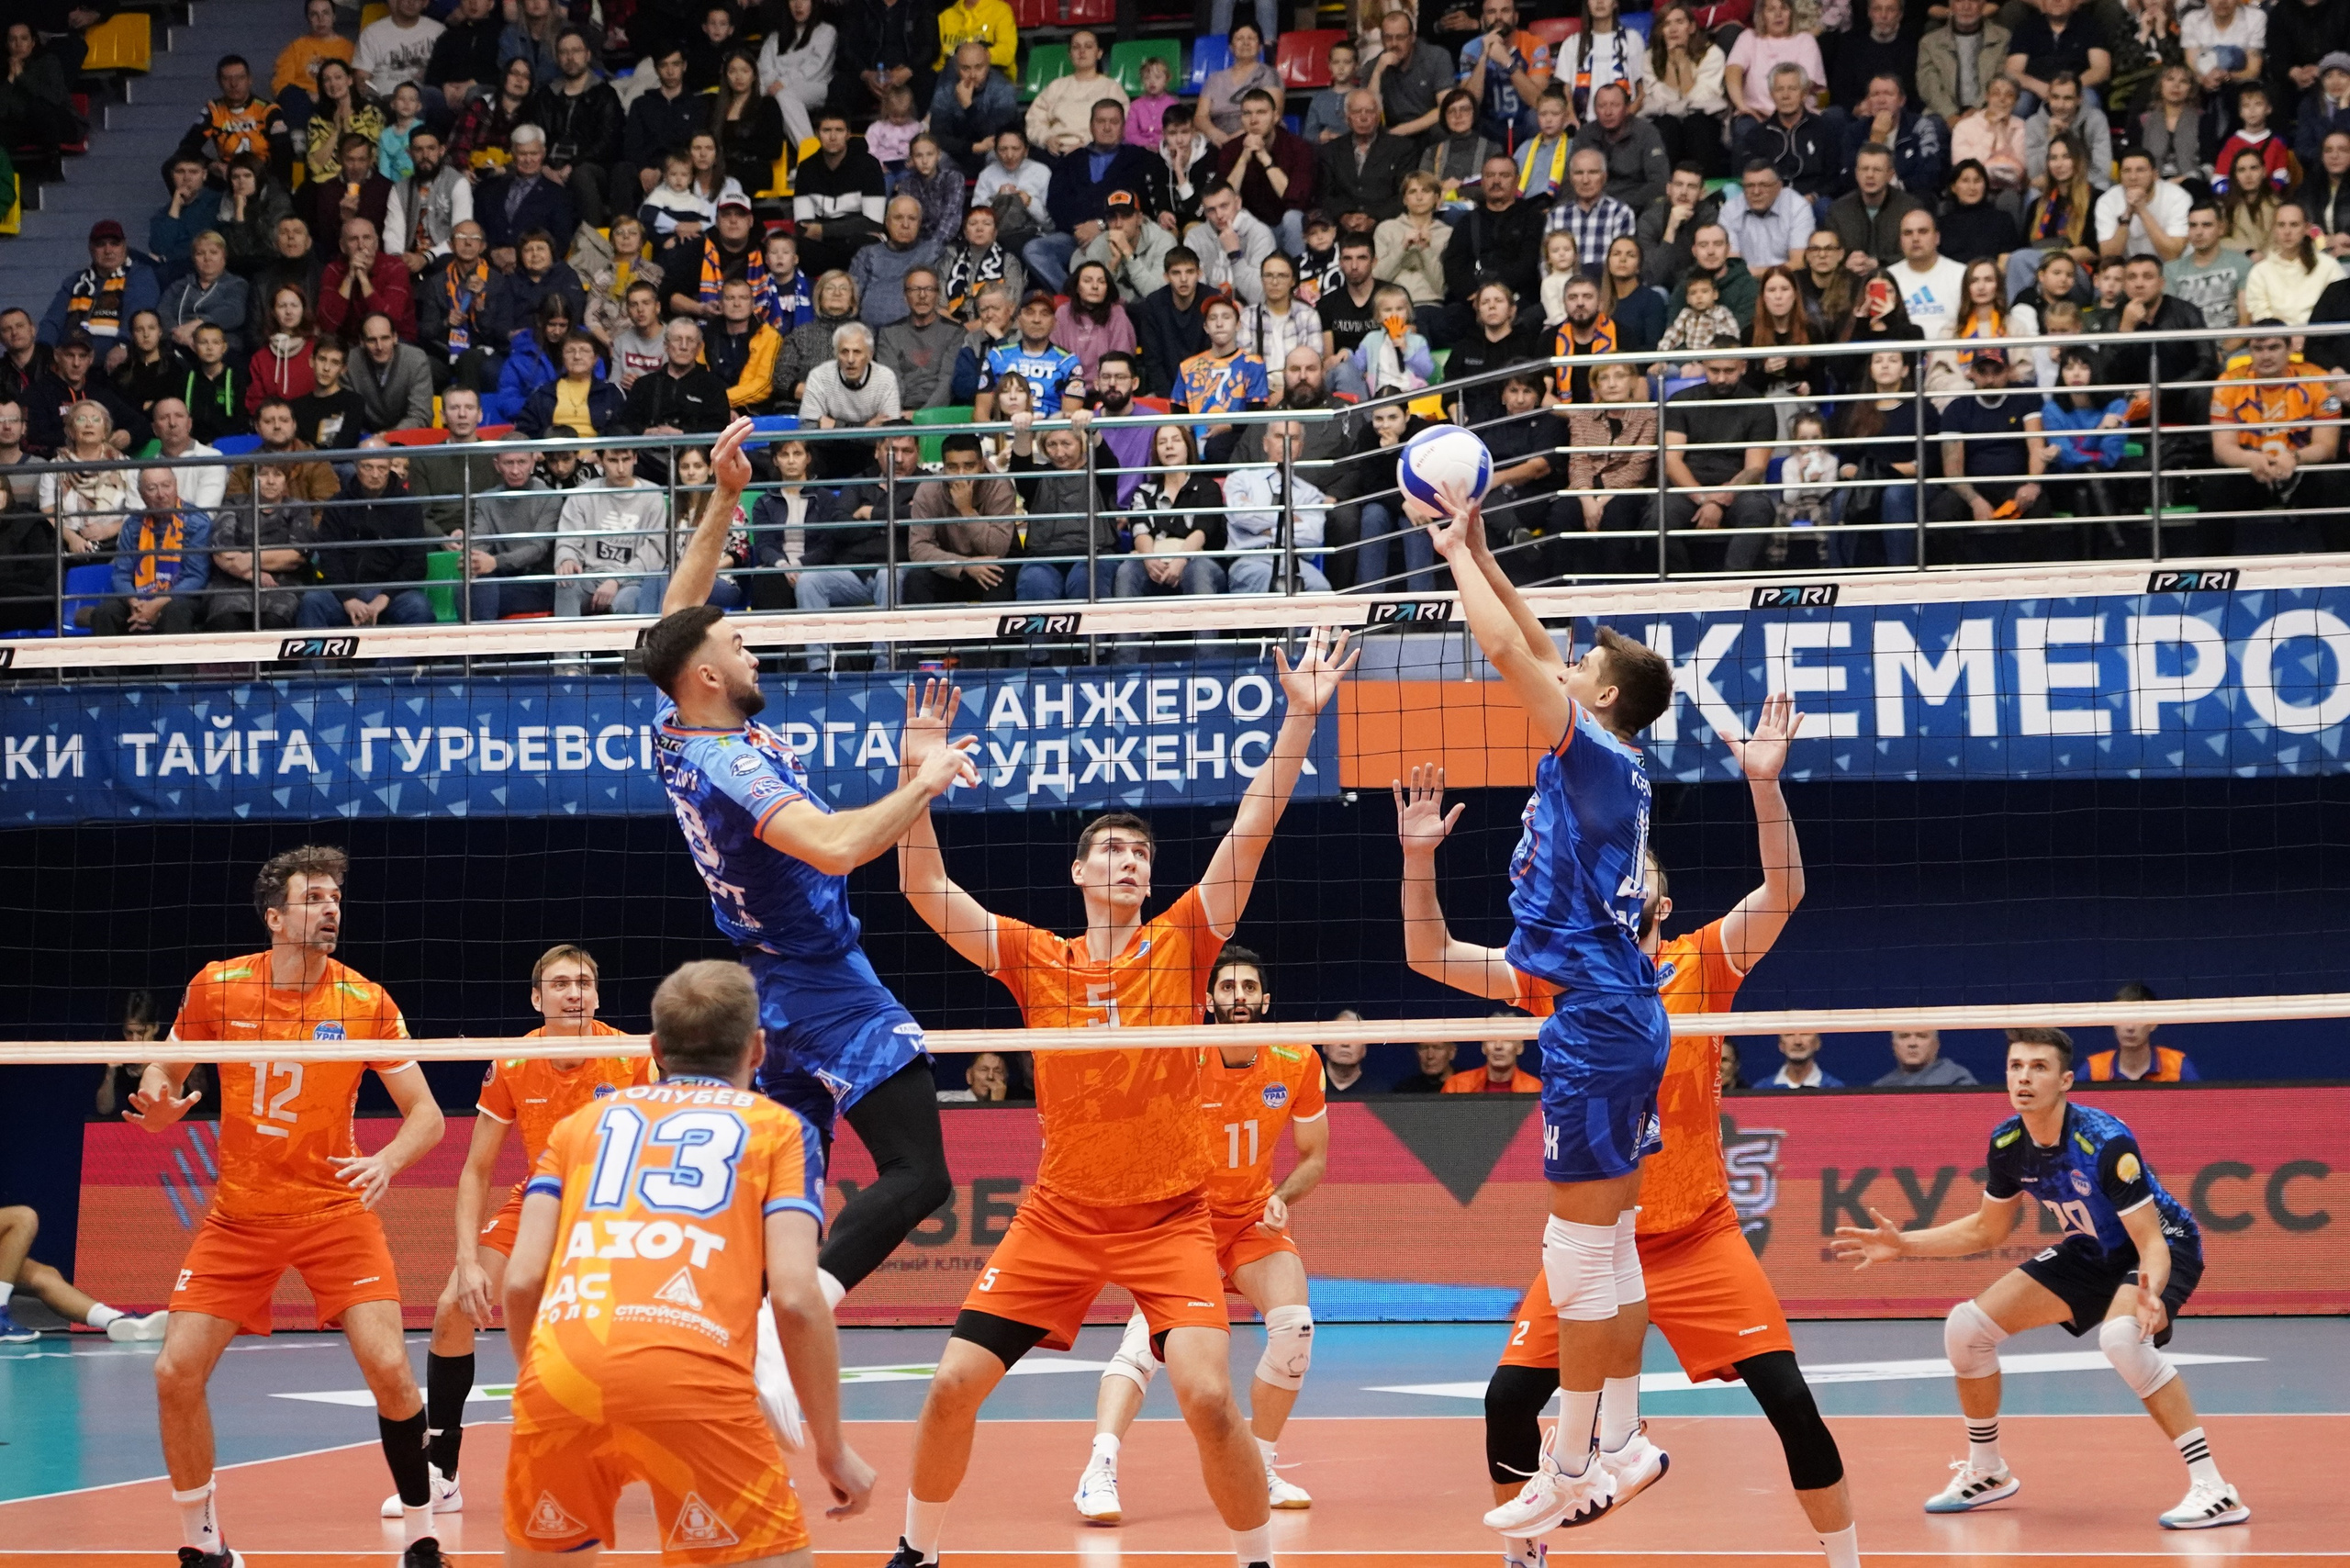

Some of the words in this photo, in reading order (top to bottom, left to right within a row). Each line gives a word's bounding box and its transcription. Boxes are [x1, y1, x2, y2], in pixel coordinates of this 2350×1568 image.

[1493, 84, 1519, 113] 15
[1008, 364, 1058, 379] АЗОТ
[1211, 367, 1232, 402] 7
[599, 543, 626, 565] 574
[1645, 608, 2350, 741] КЕМЕРО
[986, 675, 1274, 731] АНЖЕРО
[119, 716, 319, 777] ТАЙГА
[362, 724, 654, 773] ГУРЬЕВС
[783, 722, 900, 767] РГА
[1085, 980, 1121, 1028] 5
[249, 1061, 304, 1124] 12
[584, 1104, 751, 1219] 13
[1224, 1118, 1259, 1169] 11
[1820, 1161, 2331, 1235] КУСС
[2042, 1199, 2098, 1239] 20
[562, 1221, 726, 1269] АЗОТ
[979, 1268, 1001, 1292] 5
[614, 1305, 731, 1341] СТРОЙСЕРВИС
[1512, 1320, 1530, 1346] 2
